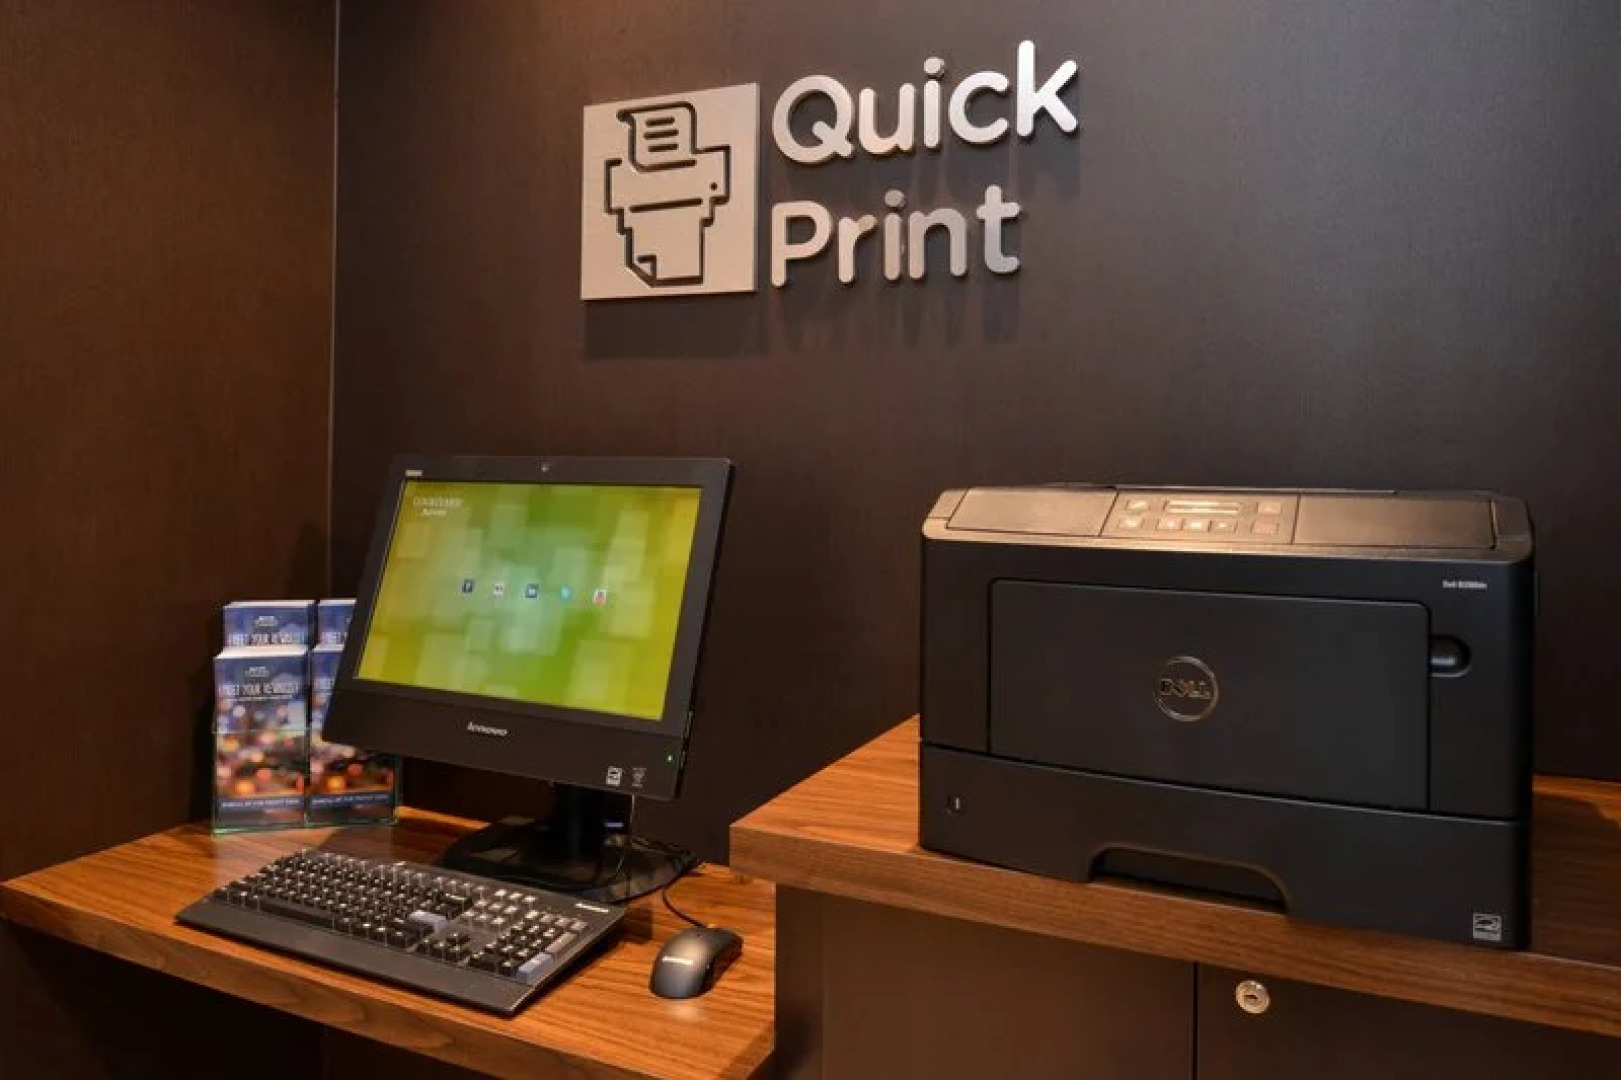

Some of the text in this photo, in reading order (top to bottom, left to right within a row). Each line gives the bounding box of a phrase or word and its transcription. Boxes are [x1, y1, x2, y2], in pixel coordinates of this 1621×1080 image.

[772, 39, 1079, 165] Quick
[770, 184, 1022, 288] Print
[1159, 678, 1211, 700] DELL
